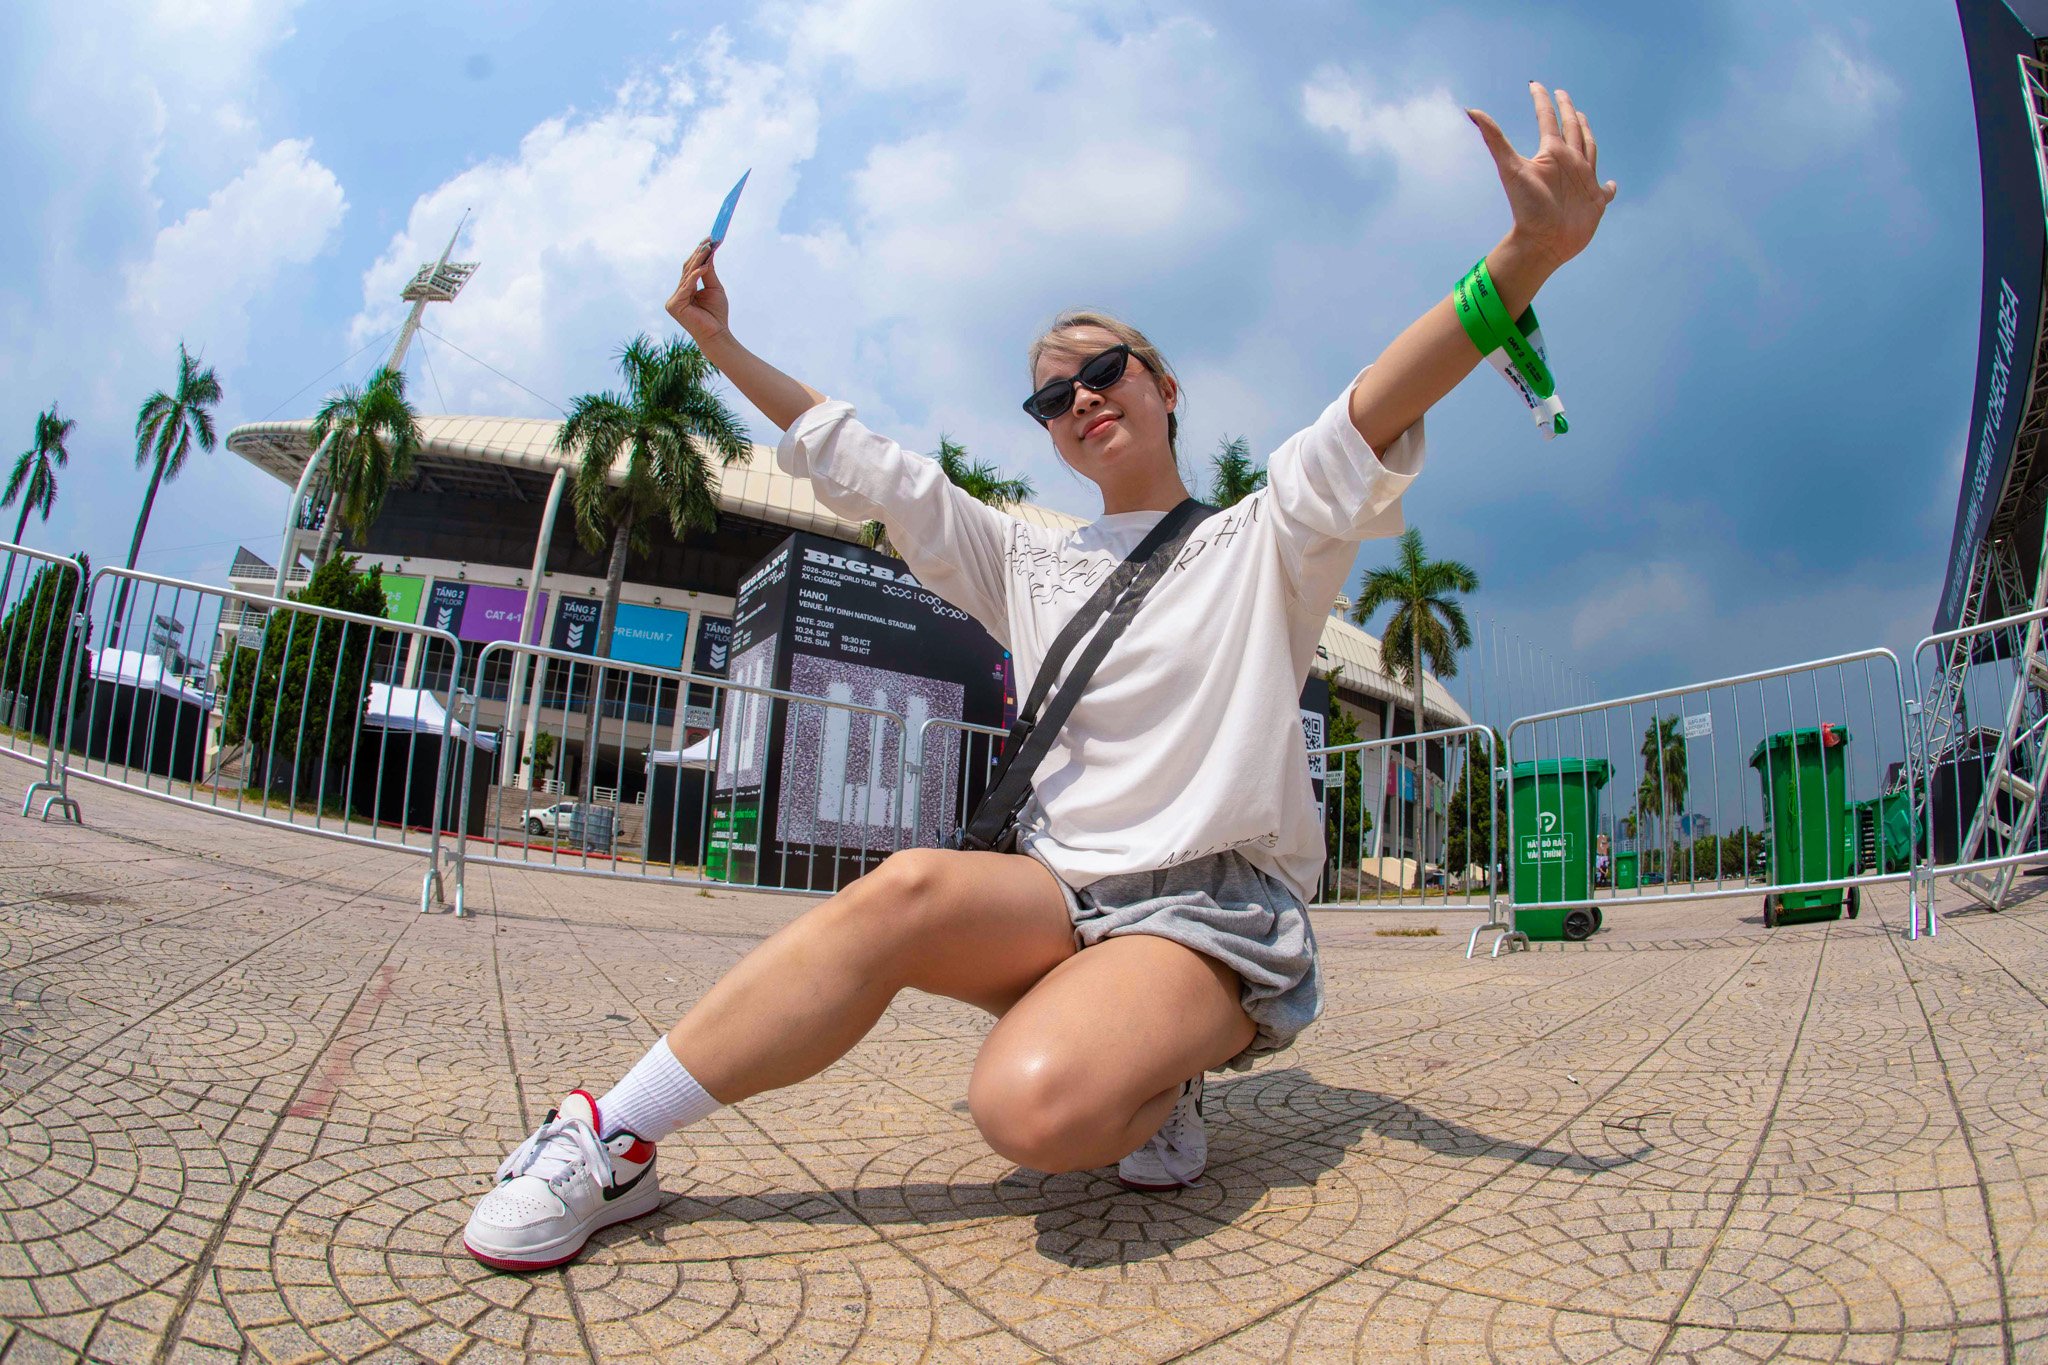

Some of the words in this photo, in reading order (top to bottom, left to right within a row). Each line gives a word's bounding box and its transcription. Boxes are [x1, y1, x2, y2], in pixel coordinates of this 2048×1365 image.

[1998, 276, 2020, 365] AREA
[1988, 344, 2010, 431] CHECK
[1975, 411, 1998, 502] SECURITY
[804, 549, 922, 588] BIGBA
[860, 578, 877, 588] TOUR
[457, 590, 464, 599] 2
[799, 588, 828, 602] HANOI
[443, 597, 463, 607] FLOOR
[485, 609, 505, 621] CAT
[590, 605, 597, 615] 2
[799, 600, 823, 612] VENUE.
[824, 604, 836, 614] MY
[837, 607, 853, 617] DINH
[854, 611, 887, 625] NATIONAL
[888, 619, 916, 631] STADIUM
[572, 612, 595, 623] FLOOR
[796, 616, 815, 626] DATE.
[816, 620, 834, 630] 2026
[665, 633, 673, 642] 7
[795, 626, 815, 636] 10.24.
[816, 630, 829, 639] SAT
[841, 635, 859, 646] 19:30
[860, 639, 871, 647] ICT
[794, 635, 814, 646] 10.25.
[815, 638, 831, 648] SUN
[840, 644, 858, 654] 19:30
[859, 647, 871, 656] ICT
